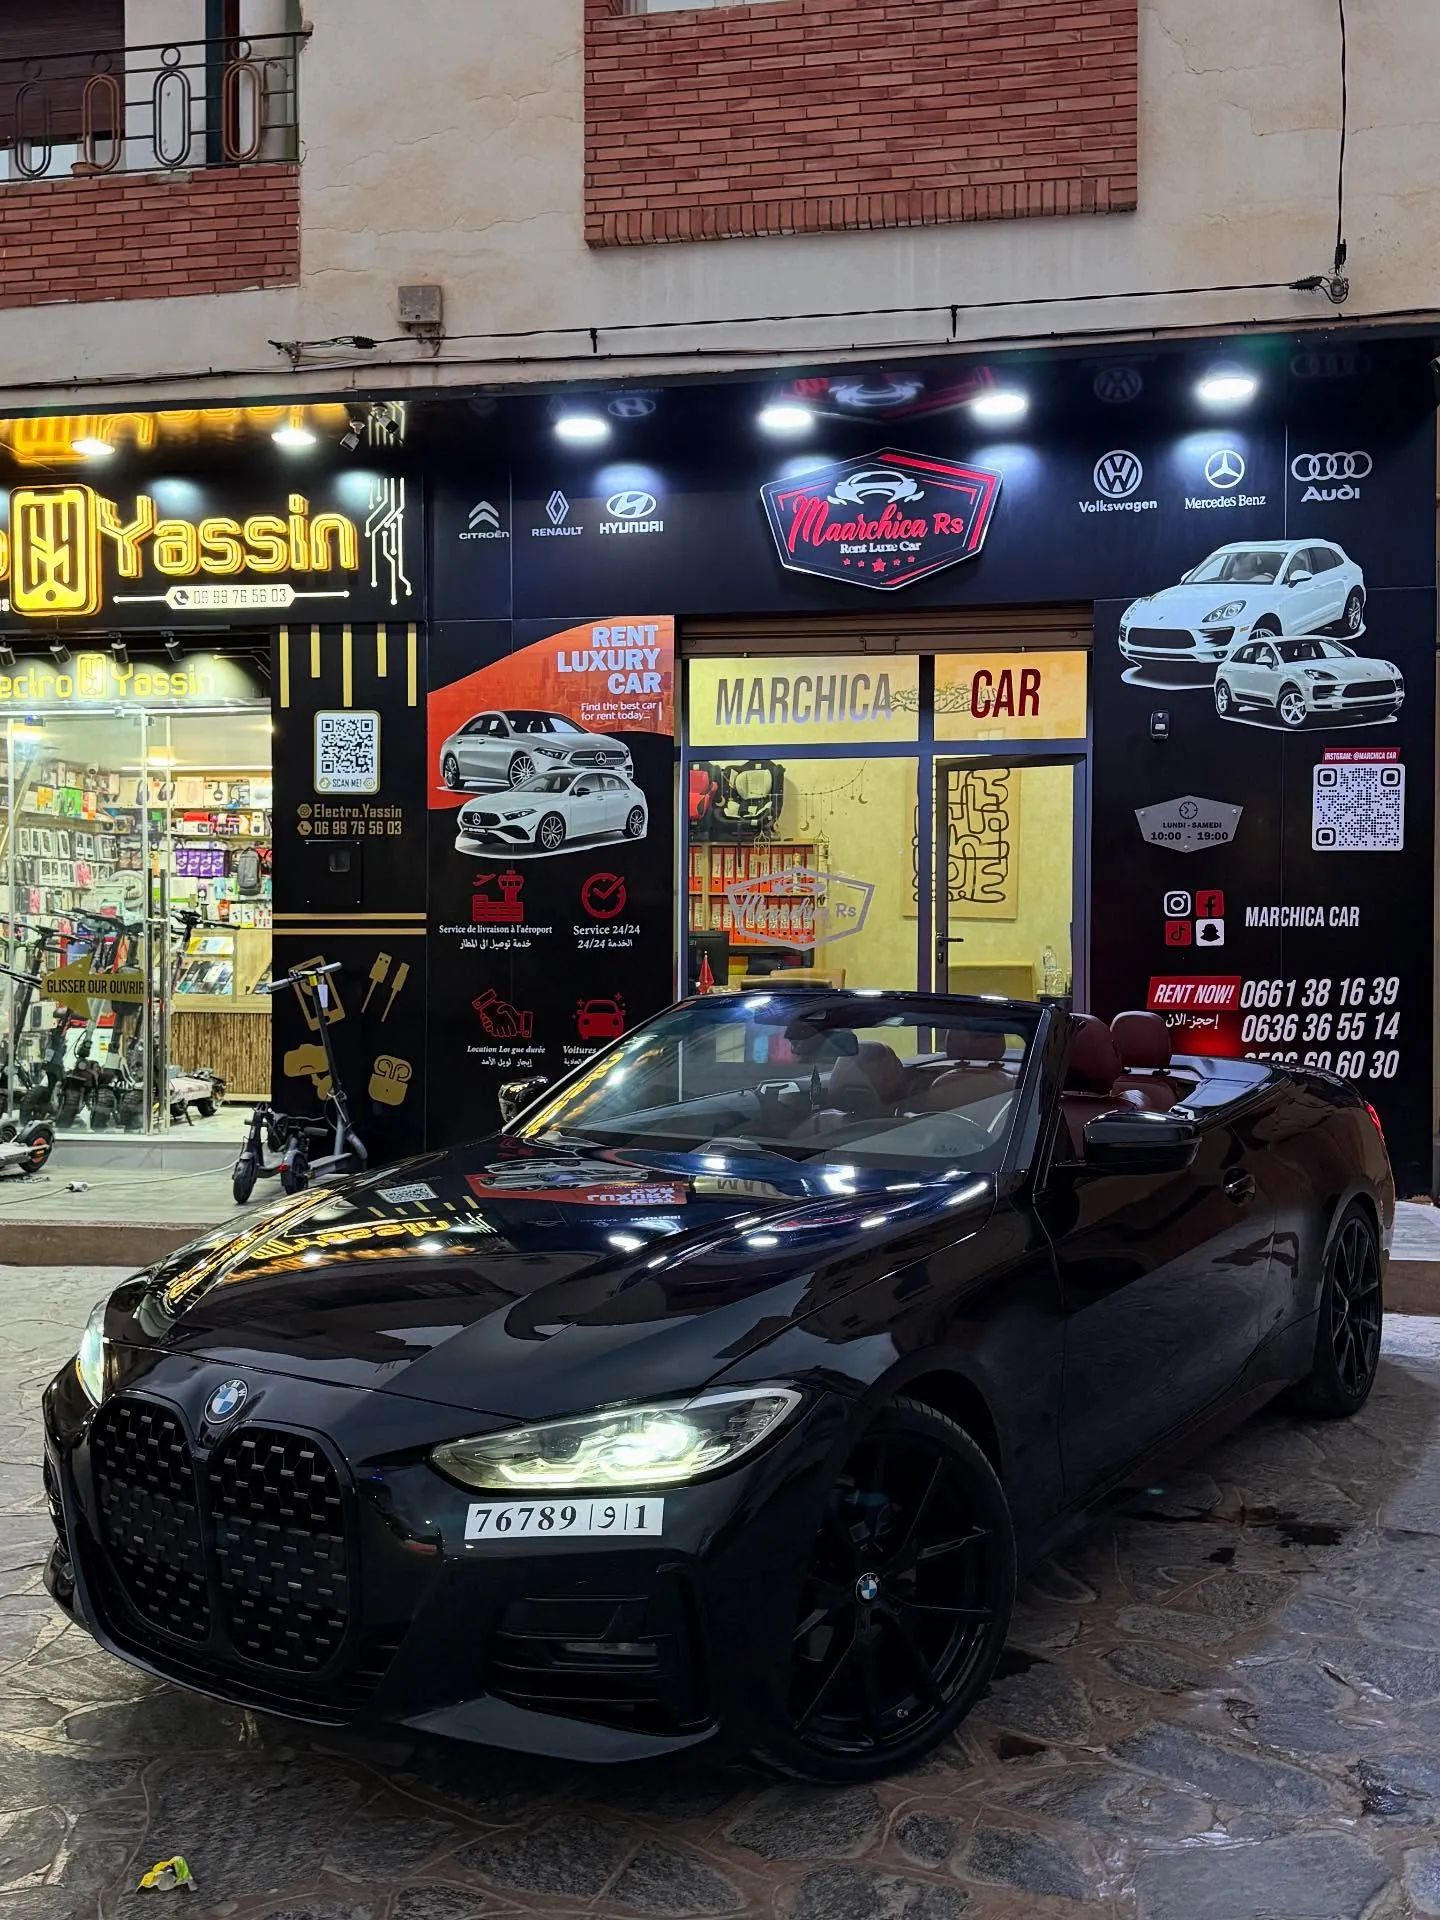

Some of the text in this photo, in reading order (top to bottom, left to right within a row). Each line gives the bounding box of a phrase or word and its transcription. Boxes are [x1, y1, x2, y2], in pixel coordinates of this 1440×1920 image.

[1301, 485, 1360, 502] Audi
[1079, 498, 1157, 514] Volkswagen
[1184, 494, 1266, 510] Mercedes Benz
[531, 526, 583, 537] RENAULT
[600, 521, 664, 535] HYUNDAI
[788, 495, 964, 553] Maarchica Rs
[97, 494, 359, 577] Yassin
[840, 541, 921, 554] Rent Luxe Car
[193, 590, 208, 604] 06
[271, 588, 287, 603] 03
[592, 625, 659, 648] RENT
[557, 648, 661, 673] LUXURY
[110, 663, 214, 697] Yassin
[607, 672, 661, 695] CAR
[715, 673, 893, 726] MARCHICA
[970, 668, 1042, 719] CAR
[581, 702, 601, 711] Find
[603, 702, 618, 711] the
[620, 701, 640, 710] best
[581, 712, 594, 721] for
[597, 712, 615, 720] rent
[1386, 751, 1397, 759] CAR
[332, 778, 362, 788] SCAN ME!
[313, 804, 402, 818] Electro.Yassin
[314, 821, 402, 835] 06 99 76 56 03
[1151, 832, 1181, 840] 10:00
[1197, 832, 1228, 840] 19:00
[1245, 906, 1360, 928] MARCHICA CAR
[439, 924, 553, 935] Service de livraison à l'aéroport
[573, 924, 640, 935] Service 24/24
[459, 939, 477, 950] المطار
[490, 939, 511, 950] توصيل
[513, 939, 532, 948] خدمة
[577, 938, 633, 949] الخدمة 24/24
[47, 979, 144, 995] GLISSER OUR OUVRIR
[1153, 983, 1235, 1004] RENT NOW!
[1240, 976, 1400, 1008] 0661 38 16 39
[1241, 1011, 1400, 1043] 0636 36 55 14
[467, 1045, 497, 1053] Location
[562, 1045, 597, 1054] Voitures
[1335, 1051, 1365, 1079] 60
[1369, 1050, 1400, 1079] 30
[475, 1505, 577, 1533] 76789
[633, 1504, 649, 1529] 1
